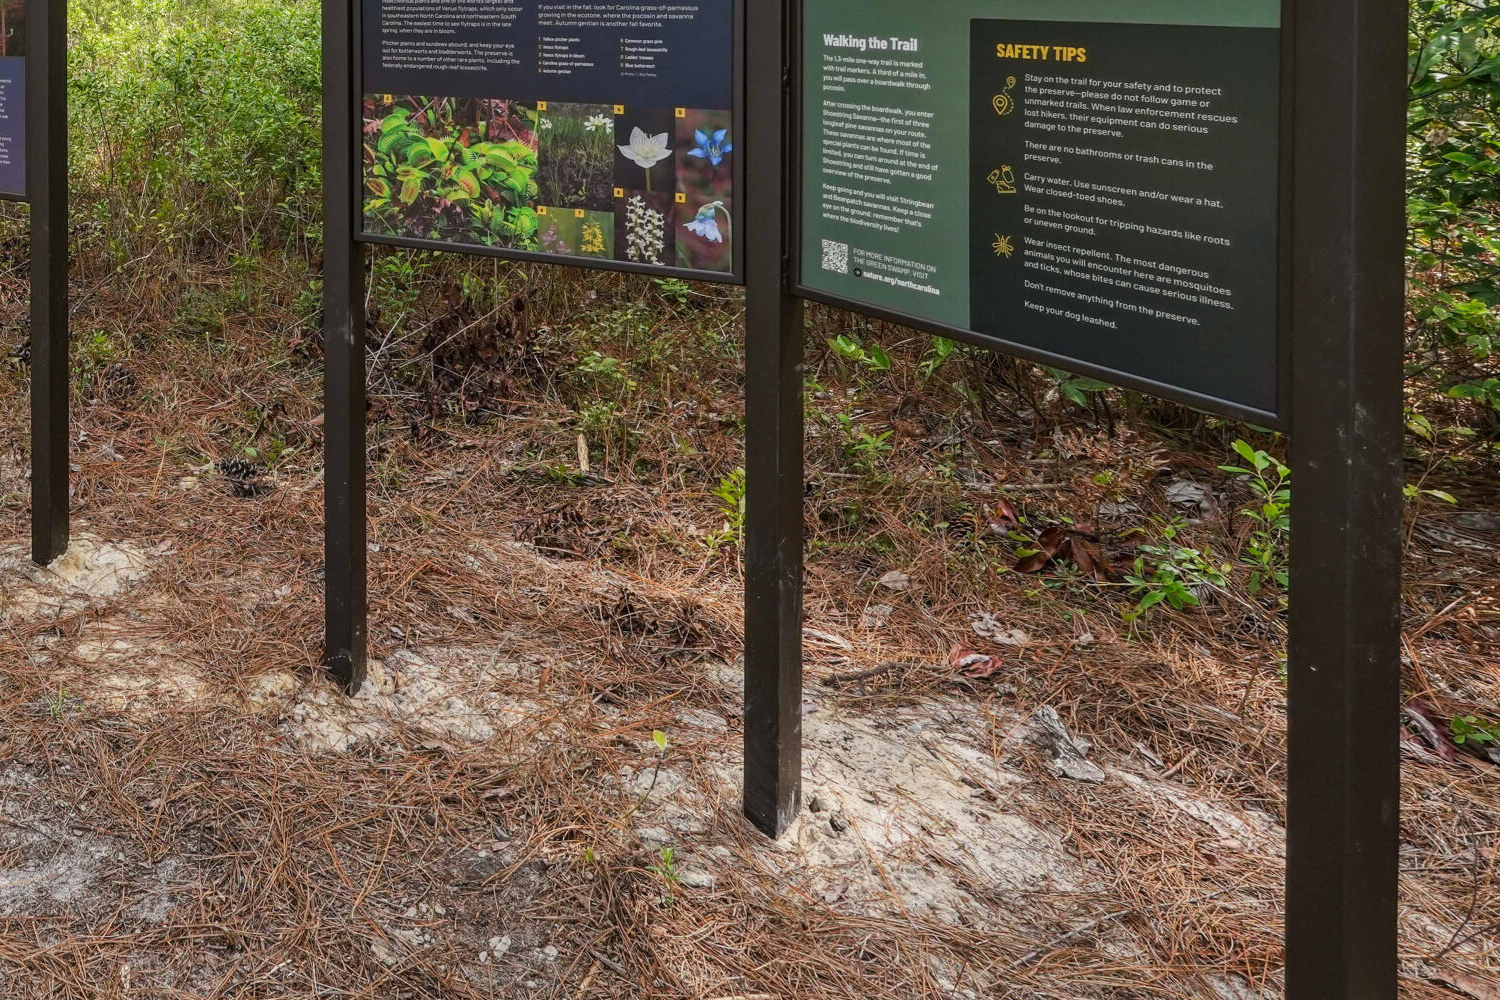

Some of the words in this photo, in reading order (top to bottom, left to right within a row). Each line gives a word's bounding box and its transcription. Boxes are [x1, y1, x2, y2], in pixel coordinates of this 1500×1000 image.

[822, 33, 866, 50] Walking
[867, 36, 888, 49] the
[889, 37, 918, 51] Trail
[996, 43, 1049, 59] SAFETY
[1052, 46, 1086, 62] TIPS
[1024, 73, 1042, 83] Stay
[1055, 76, 1069, 84] the
[1070, 77, 1087, 85] trail
[1088, 78, 1101, 86] for
[1123, 81, 1152, 91] safety
[1152, 83, 1171, 91] and
[1172, 84, 1183, 92] to
[1184, 86, 1221, 95] protect
[1024, 85, 1038, 93] the
[1110, 92, 1122, 100] do
[1140, 94, 1169, 103] follow
[1169, 98, 1197, 106] game
[1024, 98, 1064, 108] unmarked
[1066, 102, 1089, 110] trails.
[1091, 103, 1116, 113] When
[1117, 105, 1133, 114] law
[1135, 106, 1195, 120] enforcement
[1197, 113, 1238, 123] rescues
[1024, 108, 1039, 116] lost
[1068, 113, 1089, 121] their
[1090, 116, 1138, 126] equipment
[1158, 121, 1170, 129] do
[1171, 124, 1208, 133] serious
[1024, 120, 1056, 131] damage
[1067, 124, 1081, 132] the
[1082, 127, 1123, 137] preserve.
[1023, 153, 1061, 163] preserve.
[1024, 140, 1047, 150] There
[1048, 144, 1062, 152] are
[1075, 147, 1122, 159] bathrooms
[1135, 154, 1159, 163] trash
[1160, 158, 1184, 166] cans
[1185, 159, 1195, 168] in
[1196, 161, 1213, 170] the
[1023, 172, 1045, 183] Carry
[1046, 177, 1071, 186] water.
[1073, 179, 1090, 188] Use
[1091, 183, 1137, 195] sunscreen
[1138, 190, 1168, 199] and/or
[1170, 195, 1194, 203] wear
[1203, 197, 1223, 208] hat.
[1023, 183, 1044, 193] Wear
[1045, 188, 1095, 201] closed-toed
[1096, 195, 1125, 206] shoes.
[1023, 204, 1034, 212] Be
[1047, 208, 1061, 217] the
[1062, 211, 1094, 222] lookout
[1095, 216, 1108, 224] for
[1109, 219, 1144, 233] tripping
[1145, 225, 1183, 237] hazards
[1184, 231, 1201, 241] like
[1203, 235, 1230, 245] roots
[1033, 219, 1063, 229] uneven
[1063, 224, 1095, 235] ground.
[866, 251, 882, 260] MORE
[884, 256, 925, 269] INFORMATION
[1023, 236, 1044, 246] Wear
[1045, 240, 1071, 252] insect
[1072, 247, 1112, 259] repellent.
[1114, 253, 1131, 263] The
[1132, 258, 1156, 268] most
[1158, 262, 1209, 278] dangerous
[862, 271, 940, 295] nature.org/northcarolina
[1023, 249, 1054, 260] animals
[1055, 255, 1070, 263] you
[1071, 258, 1086, 266] will
[1087, 262, 1132, 275] encounter
[1133, 269, 1154, 280] here
[1155, 275, 1171, 283] are
[1172, 279, 1231, 295] mosquitoes
[1023, 260, 1039, 268] and
[1039, 263, 1061, 274] ticks,
[1063, 269, 1090, 279] whose
[1091, 273, 1113, 284] bites
[1114, 279, 1131, 288] can
[1132, 283, 1160, 294] cause
[1161, 289, 1197, 301] serious
[1198, 295, 1233, 309] illness.
[1024, 300, 1044, 312] Keep
[1045, 306, 1063, 315] your
[1064, 310, 1080, 321] dog
[1081, 314, 1117, 328] leashed.
[1045, 286, 1075, 297] remove
[1076, 293, 1114, 307] anything
[1115, 300, 1137, 311] from
[1138, 305, 1153, 315] the
[1155, 310, 1200, 325] preserve.
